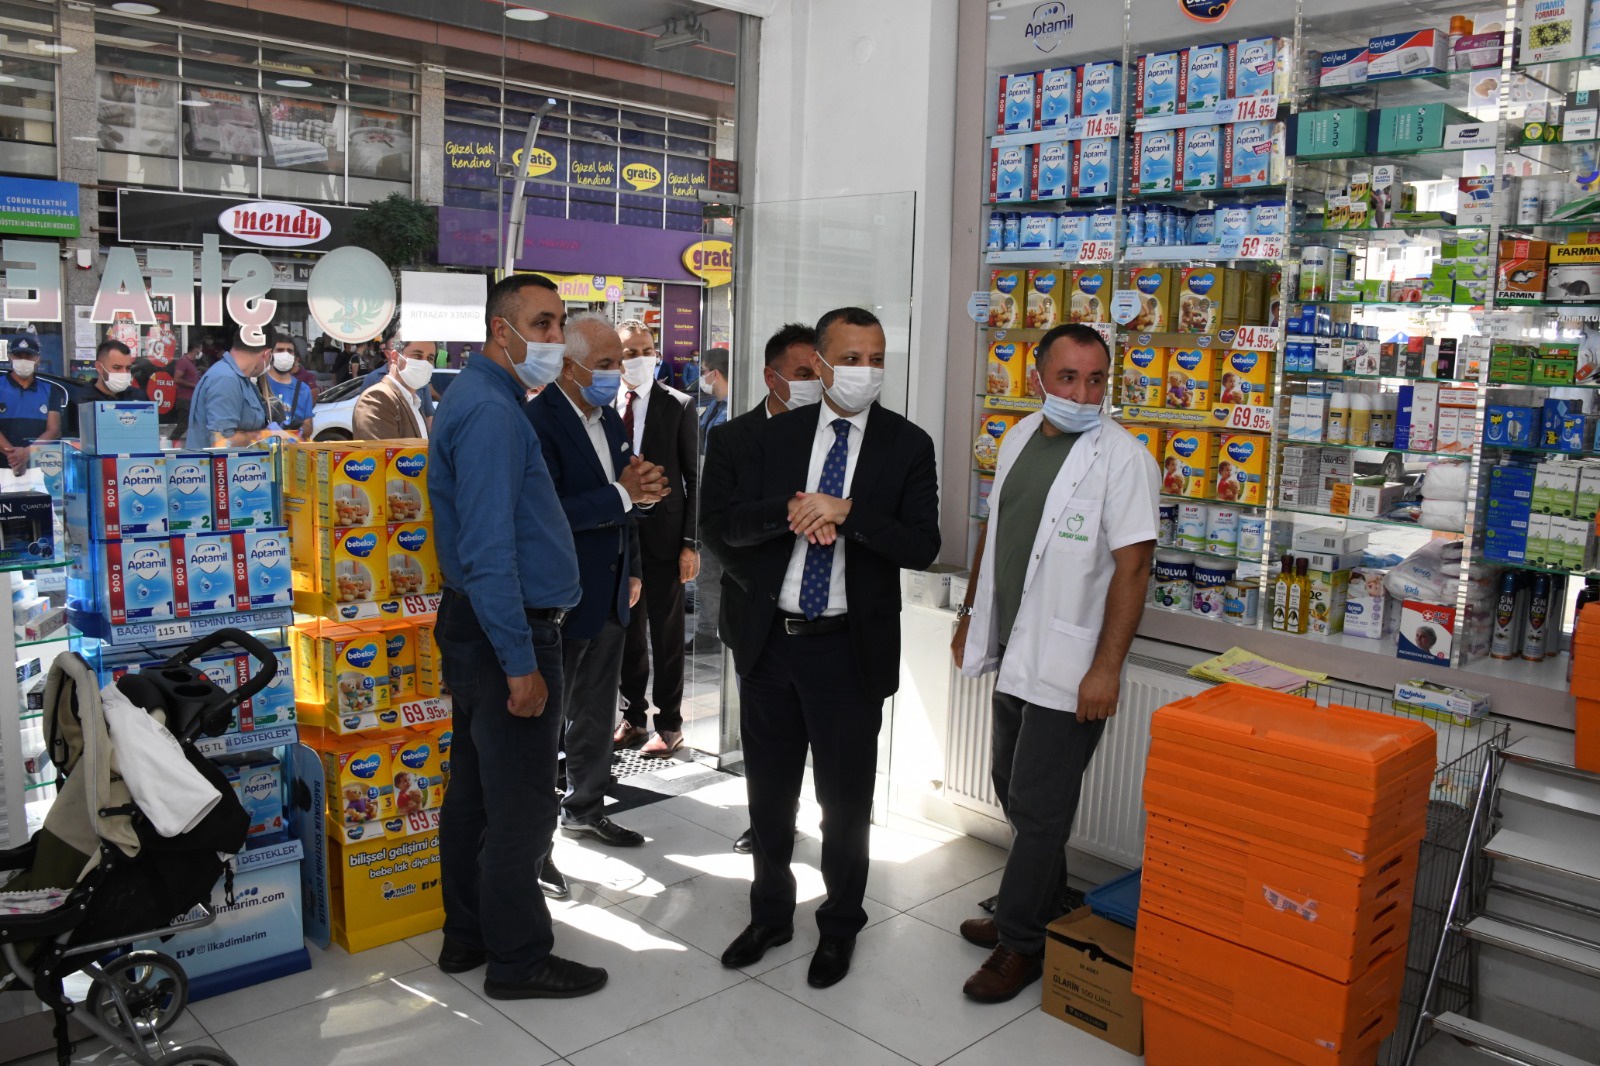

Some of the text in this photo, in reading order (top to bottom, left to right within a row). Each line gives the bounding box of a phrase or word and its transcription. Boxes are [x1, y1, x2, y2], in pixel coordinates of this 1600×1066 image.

[1535, 8, 1565, 20] FORMULA
[1025, 15, 1074, 38] Aptamil
[1191, 60, 1218, 72] Aptamil
[1228, 47, 1236, 90] EKONOMİK
[1148, 66, 1173, 78] Aptamil
[1086, 76, 1110, 86] Aptamil
[1008, 88, 1031, 97] Aptamil
[1045, 82, 1068, 92] Aptamil
[1167, 101, 1174, 112] 2
[1188, 139, 1214, 150] Aptamil
[1236, 134, 1264, 145] Aptamil
[446, 142, 495, 155] Güzel bak
[1083, 150, 1108, 158] Aptamil
[1144, 144, 1170, 153] Aptamil
[452, 156, 491, 168] kendine
[1001, 157, 1022, 166] Aptamil
[1042, 153, 1065, 162] Aptamil
[572, 160, 614, 174] Güzel bak
[626, 167, 657, 181] gratis
[668, 172, 706, 185] Güzel bak
[1258, 170, 1265, 181] 4
[577, 175, 611, 185] kendine
[1164, 178, 1170, 189] 2
[1208, 174, 1216, 186] 3
[234, 209, 321, 239] mendy
[607, 288, 619, 297] 40
[1229, 446, 1251, 454] bebelac
[346, 464, 374, 472] bebelac
[397, 460, 424, 468] bebelac
[123, 476, 162, 486] Aptamil
[169, 475, 206, 485] Aptamil
[232, 472, 267, 483] Aptamil
[1250, 485, 1256, 495] 4
[107, 488, 115, 507] 900
[21, 503, 50, 511] QUANTUM
[378, 505, 383, 516] 1
[201, 516, 210, 528] 2
[263, 512, 272, 524] 3
[161, 518, 168, 531] 1
[398, 533, 426, 542] bebelac
[347, 539, 375, 548] bebelac
[191, 552, 228, 564] Aptamil
[251, 548, 286, 559] Aptamil
[128, 559, 167, 571] Aptamil
[237, 562, 245, 580] 900
[1157, 566, 1187, 576] EVOLVIA
[176, 568, 184, 586] 900
[430, 573, 436, 583] 1
[1195, 573, 1226, 583] EVOLVIA
[112, 576, 120, 593] 900
[380, 580, 386, 590] 1
[286, 588, 293, 601] 1
[228, 594, 235, 608] 1
[166, 601, 173, 615] 1
[158, 625, 188, 636] 115 TL
[347, 650, 376, 660] bebelac
[407, 677, 413, 686] 2
[380, 689, 387, 699] 2
[1400, 688, 1426, 700] Dolphin
[287, 708, 295, 720] 3
[402, 752, 428, 761] bebelac
[352, 761, 378, 771] bebelac
[244, 779, 277, 793] Aptamil
[434, 788, 440, 797] 4
[385, 798, 392, 807] 3
[273, 816, 282, 828] 4
[350, 849, 386, 866] bilişsel
[389, 839, 428, 860] gelişimi
[370, 865, 392, 879] bebe
[394, 862, 408, 872] lak
[412, 858, 429, 869] diye
[207, 931, 267, 952] ilkadimlarim
